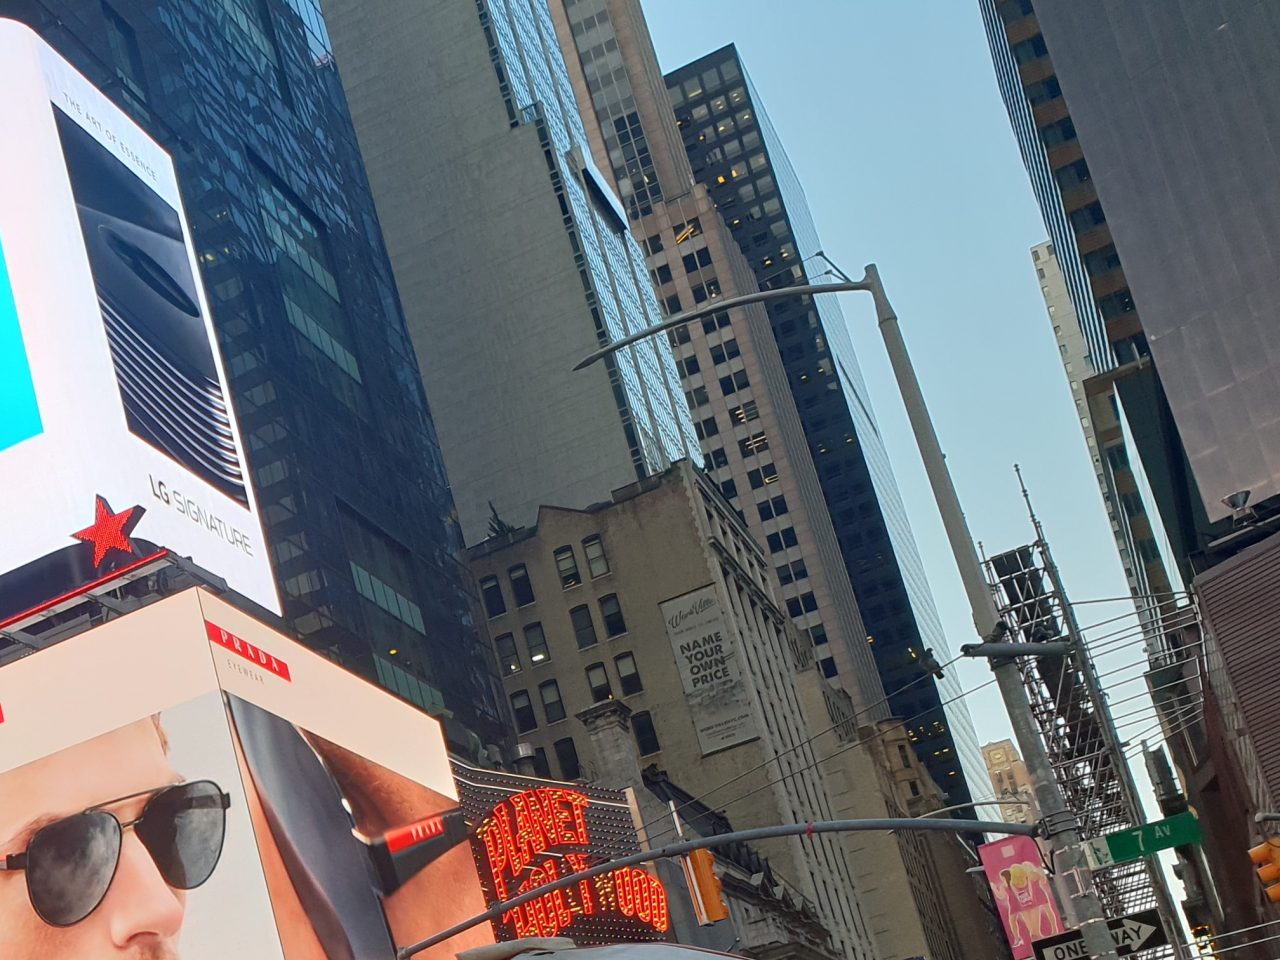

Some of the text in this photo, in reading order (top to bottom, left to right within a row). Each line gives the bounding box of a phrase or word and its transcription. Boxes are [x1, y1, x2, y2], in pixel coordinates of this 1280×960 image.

[63, 91, 158, 182] THE ART OF ESSENCE
[149, 473, 255, 558] LG SIGNATURE
[220, 630, 279, 673] PRADA
[679, 631, 723, 656] NAME
[684, 645, 724, 665] YOUR
[227, 658, 265, 685] EYEWEAR
[689, 655, 726, 676] OWN
[692, 666, 731, 688] PRICE
[476, 787, 591, 903] PLANET
[1131, 830, 1144, 851] 7
[1054, 940, 1088, 960] ONE
